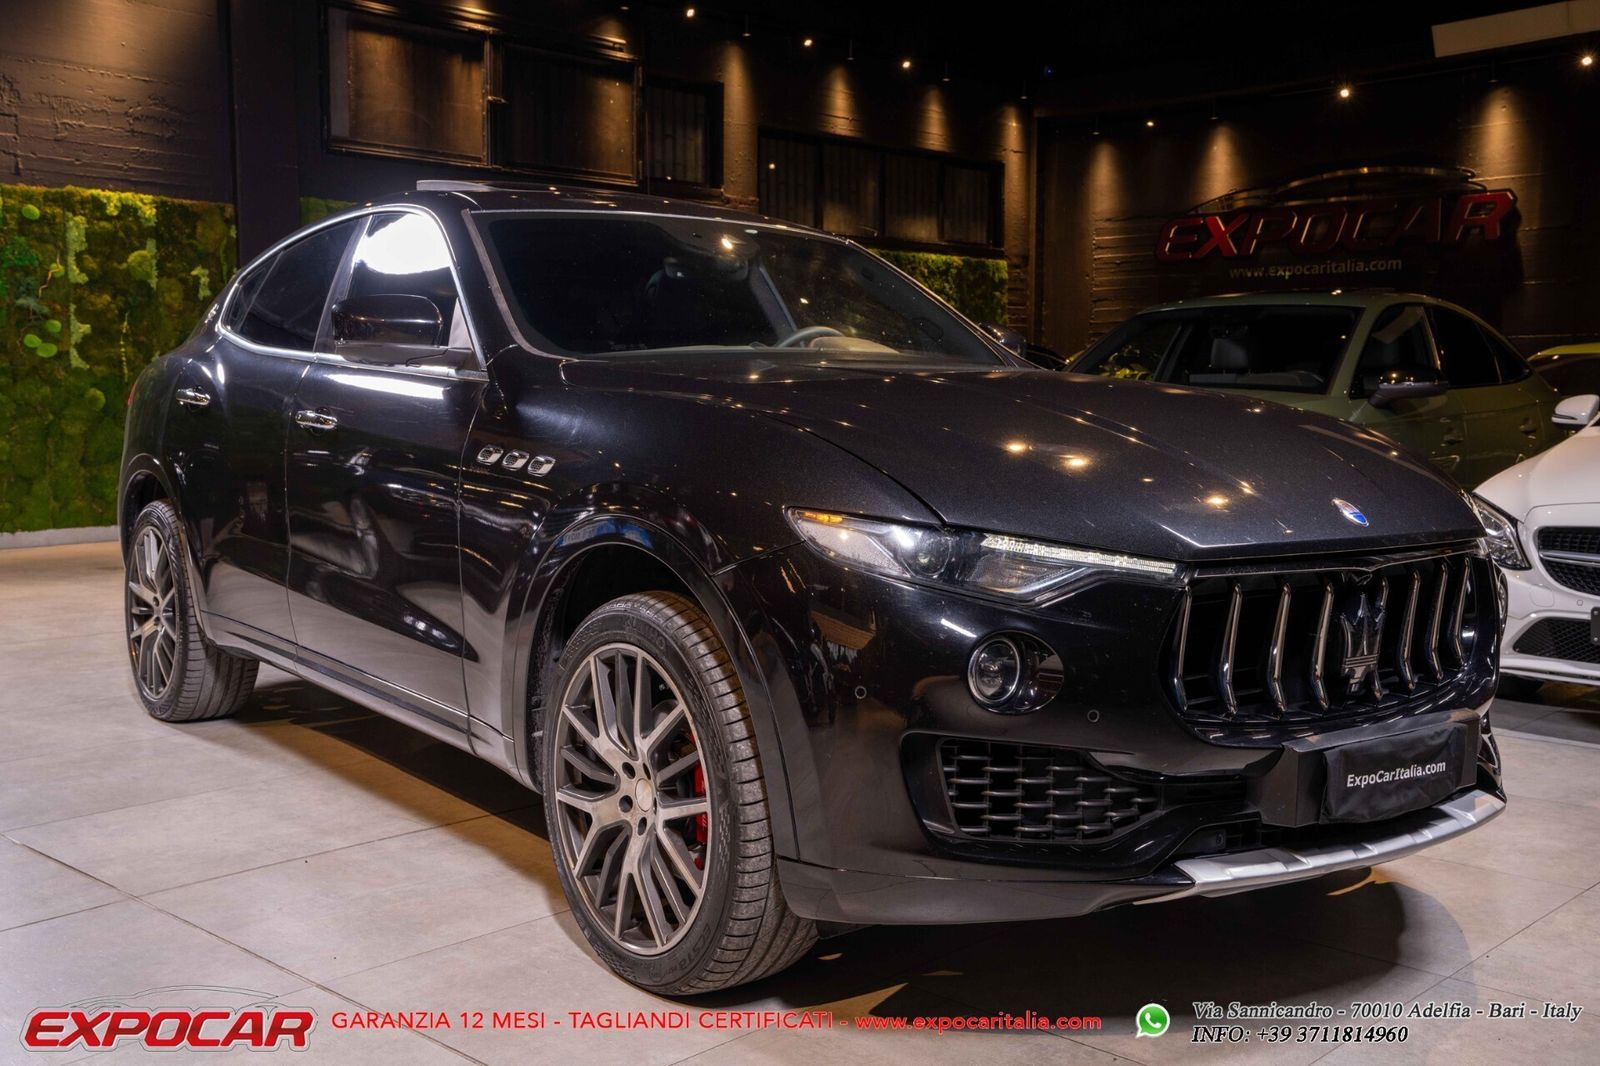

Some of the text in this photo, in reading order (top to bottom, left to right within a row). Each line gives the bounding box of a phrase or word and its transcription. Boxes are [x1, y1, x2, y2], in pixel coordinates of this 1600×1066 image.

[1157, 188, 1516, 262] EXPOCAR
[1230, 258, 1402, 280] www.expocaritalia.com
[1346, 761, 1446, 788] ExpoCarItalia.com
